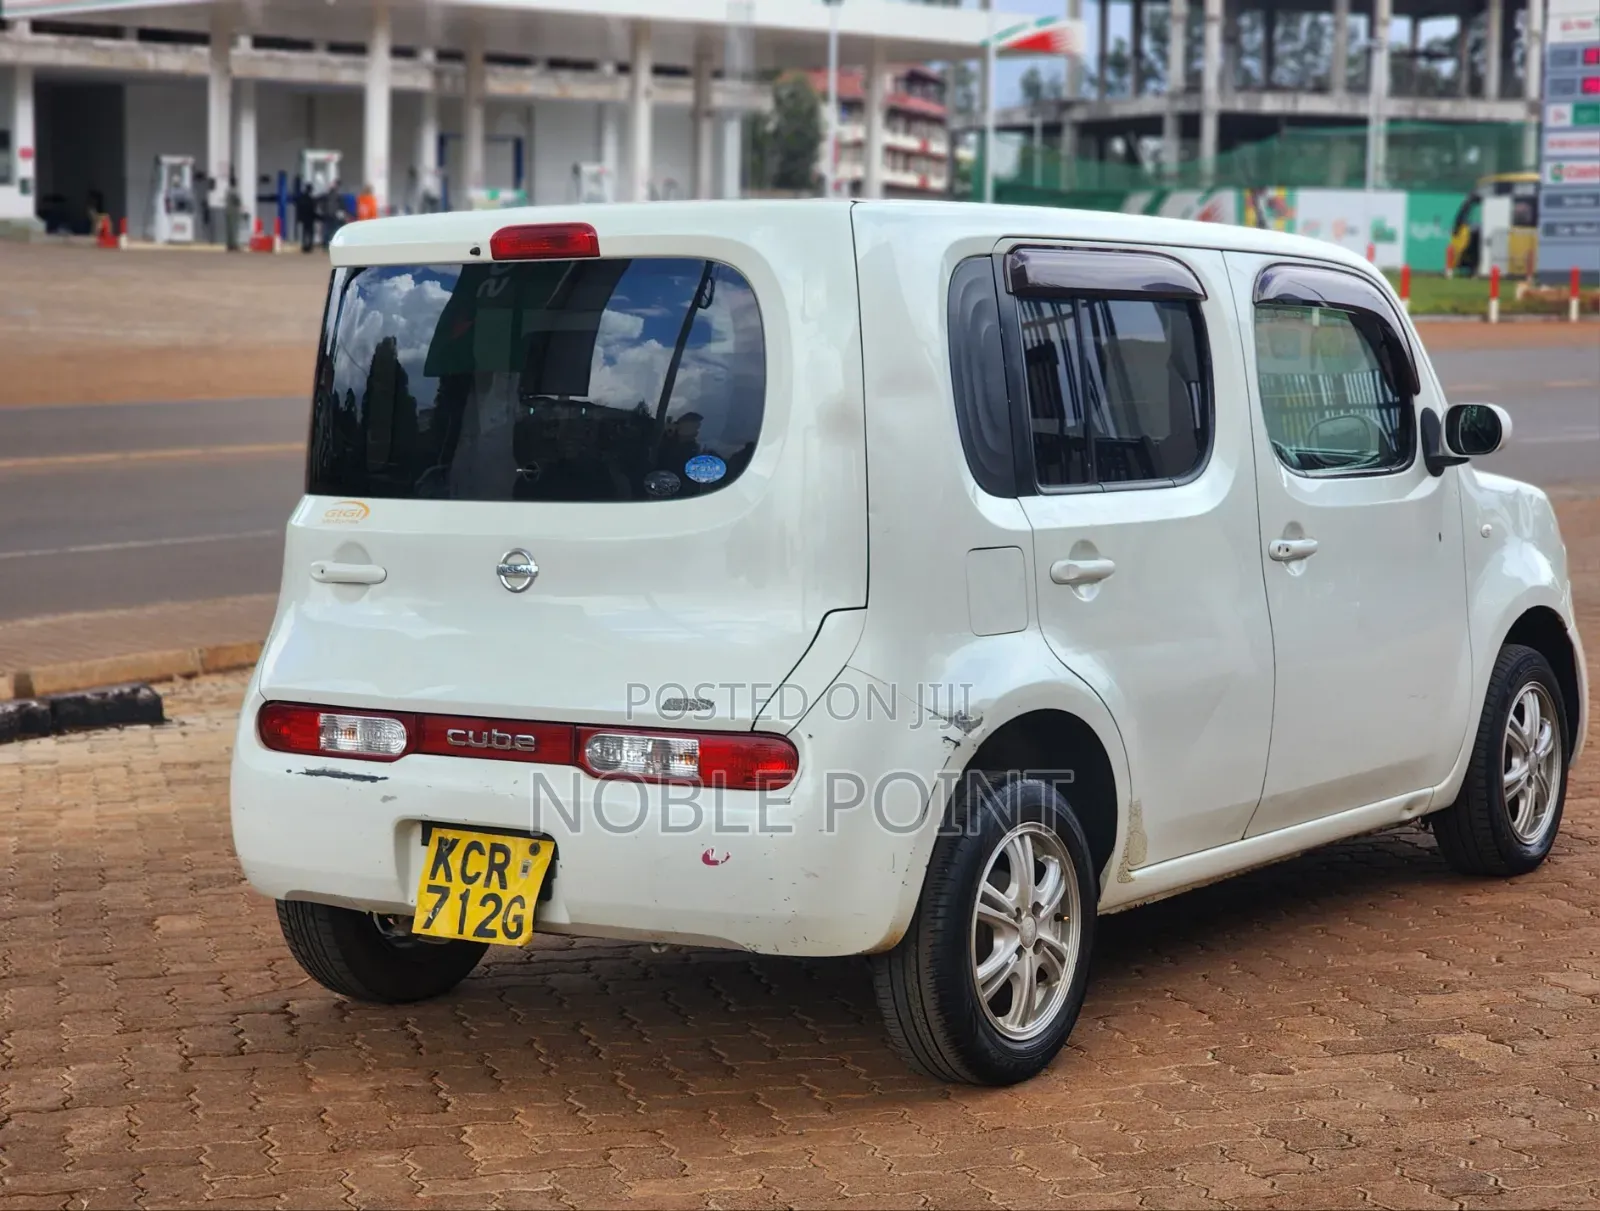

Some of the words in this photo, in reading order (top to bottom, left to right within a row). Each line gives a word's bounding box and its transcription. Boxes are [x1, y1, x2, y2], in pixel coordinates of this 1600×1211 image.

[447, 728, 535, 752] cube
[429, 836, 511, 890] KCR
[422, 884, 526, 940] 712G
